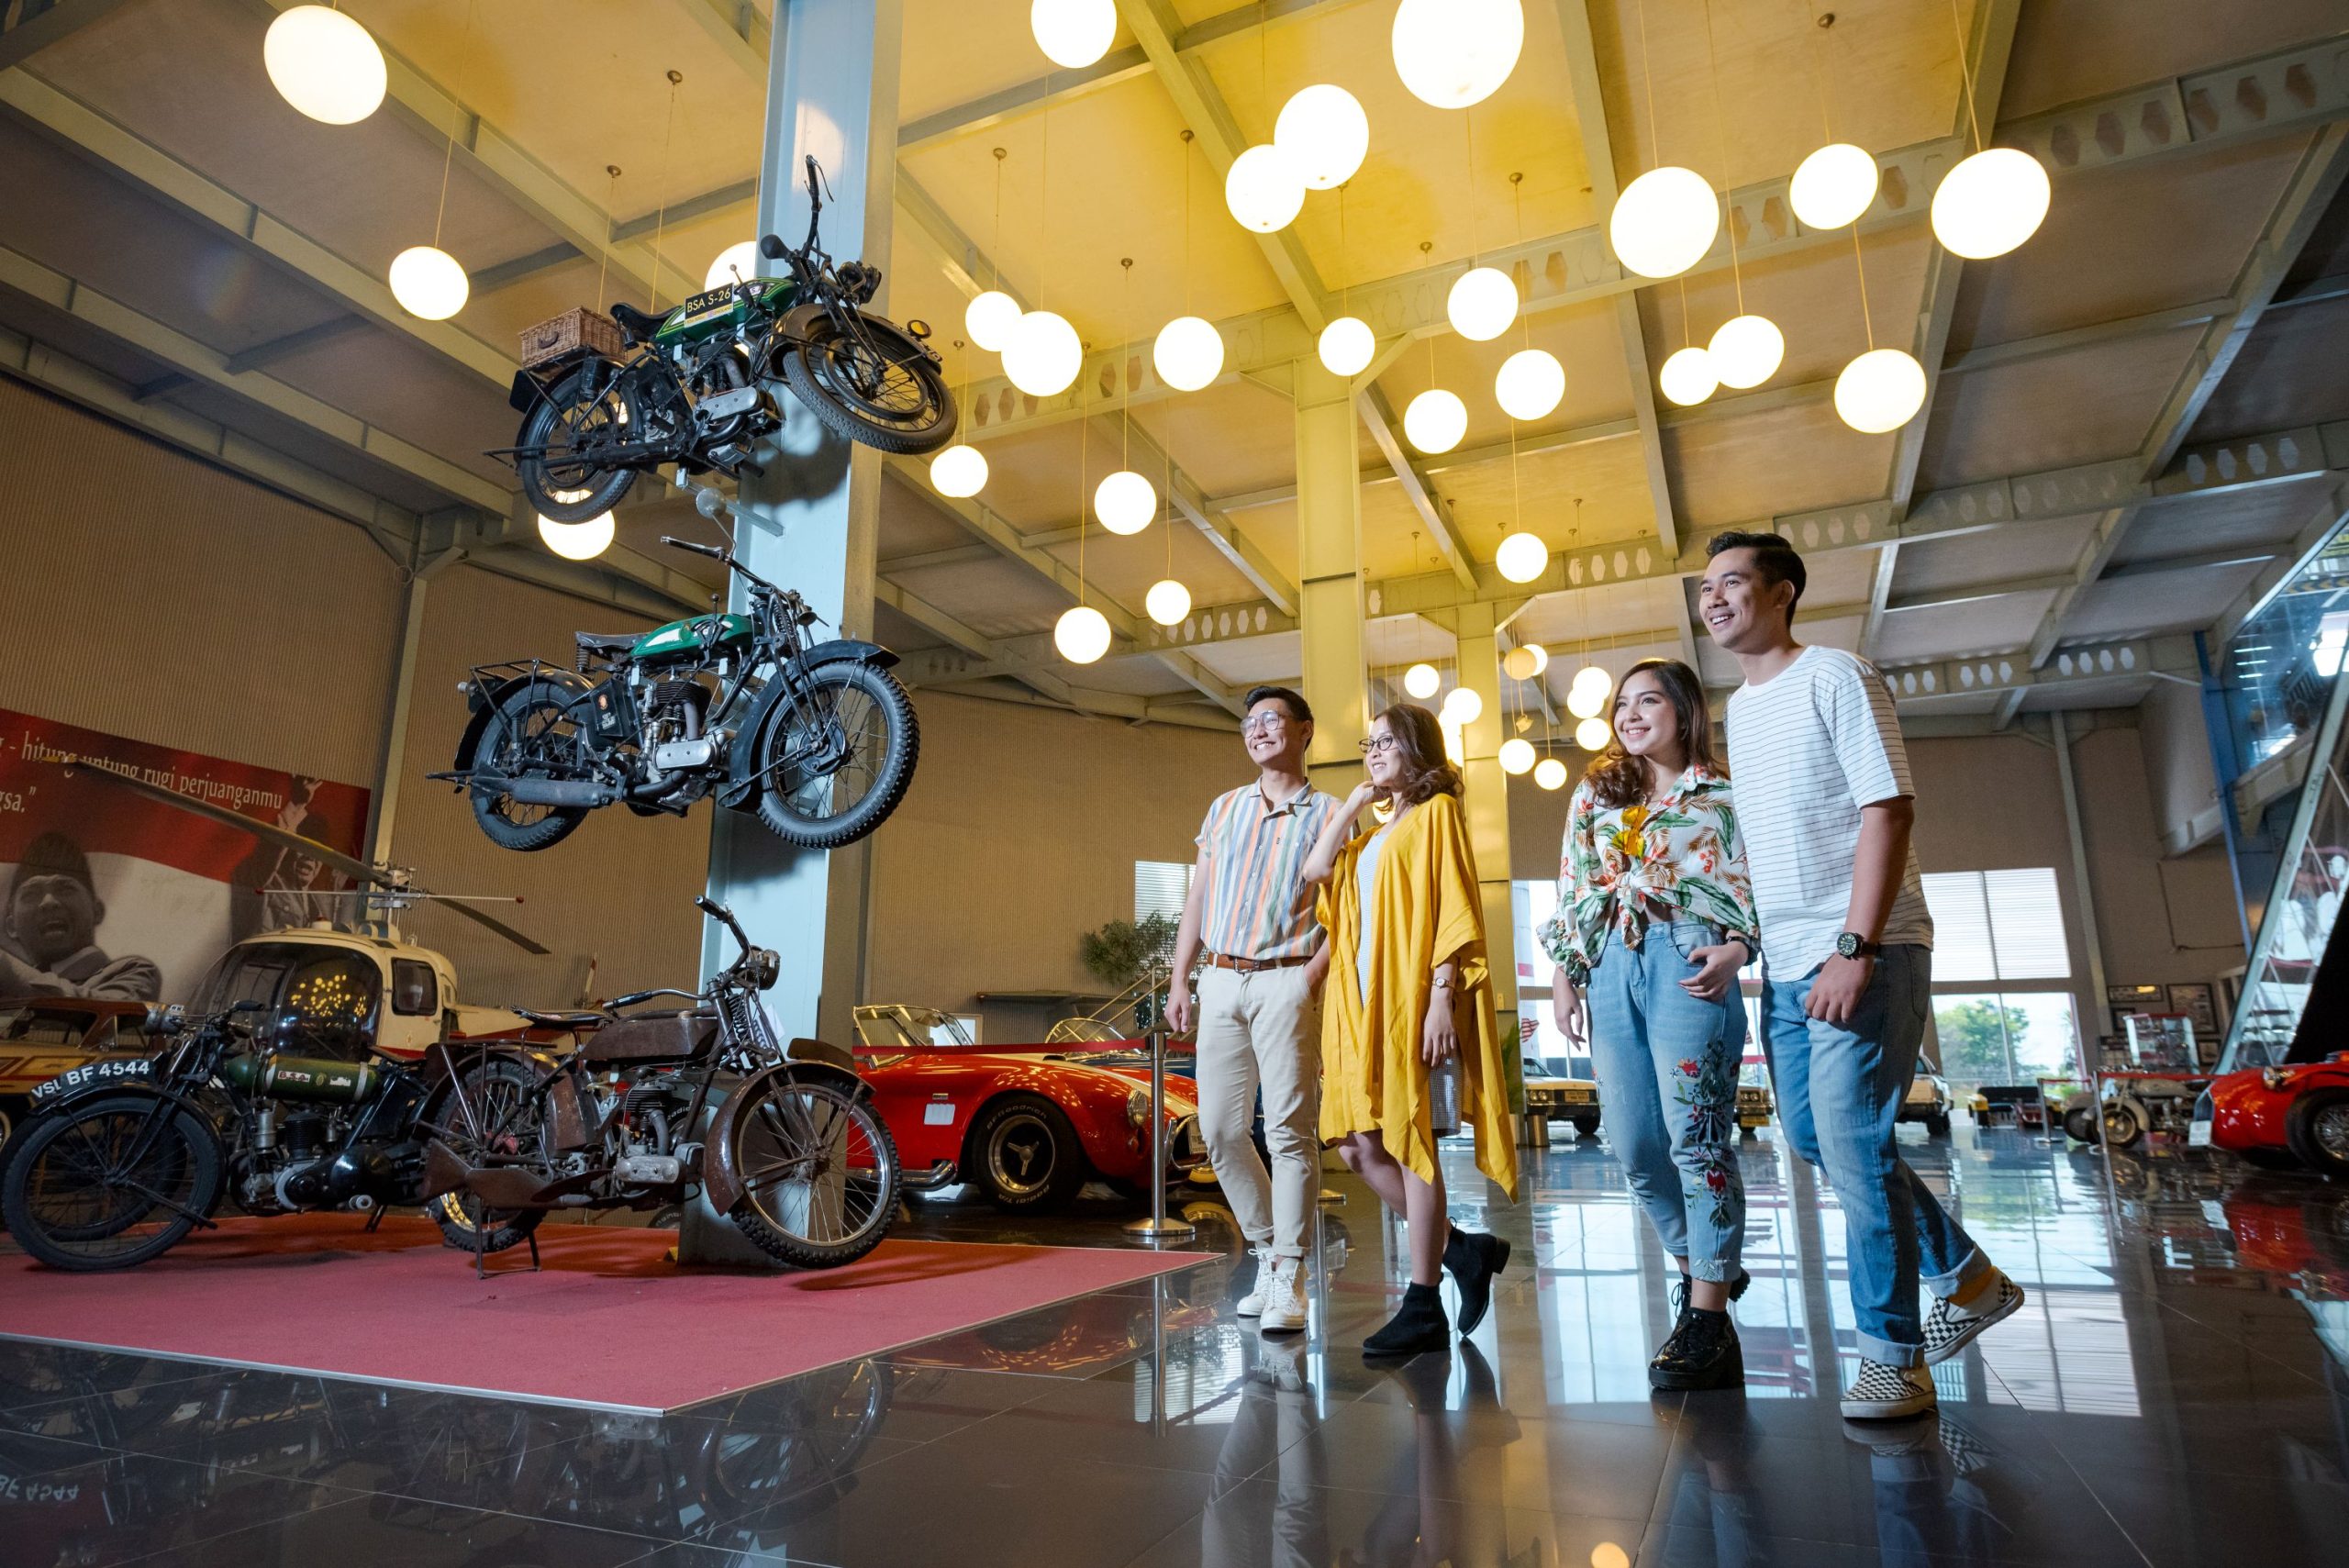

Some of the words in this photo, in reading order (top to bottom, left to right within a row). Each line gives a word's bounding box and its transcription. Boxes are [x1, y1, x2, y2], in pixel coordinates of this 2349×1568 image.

[687, 298, 706, 313] BSA
[708, 288, 731, 306] S-26
[144, 765, 175, 789] rugi
[179, 773, 283, 810] perjuanganmu
[66, 1066, 94, 1085] BF
[99, 1062, 150, 1077] 4544
